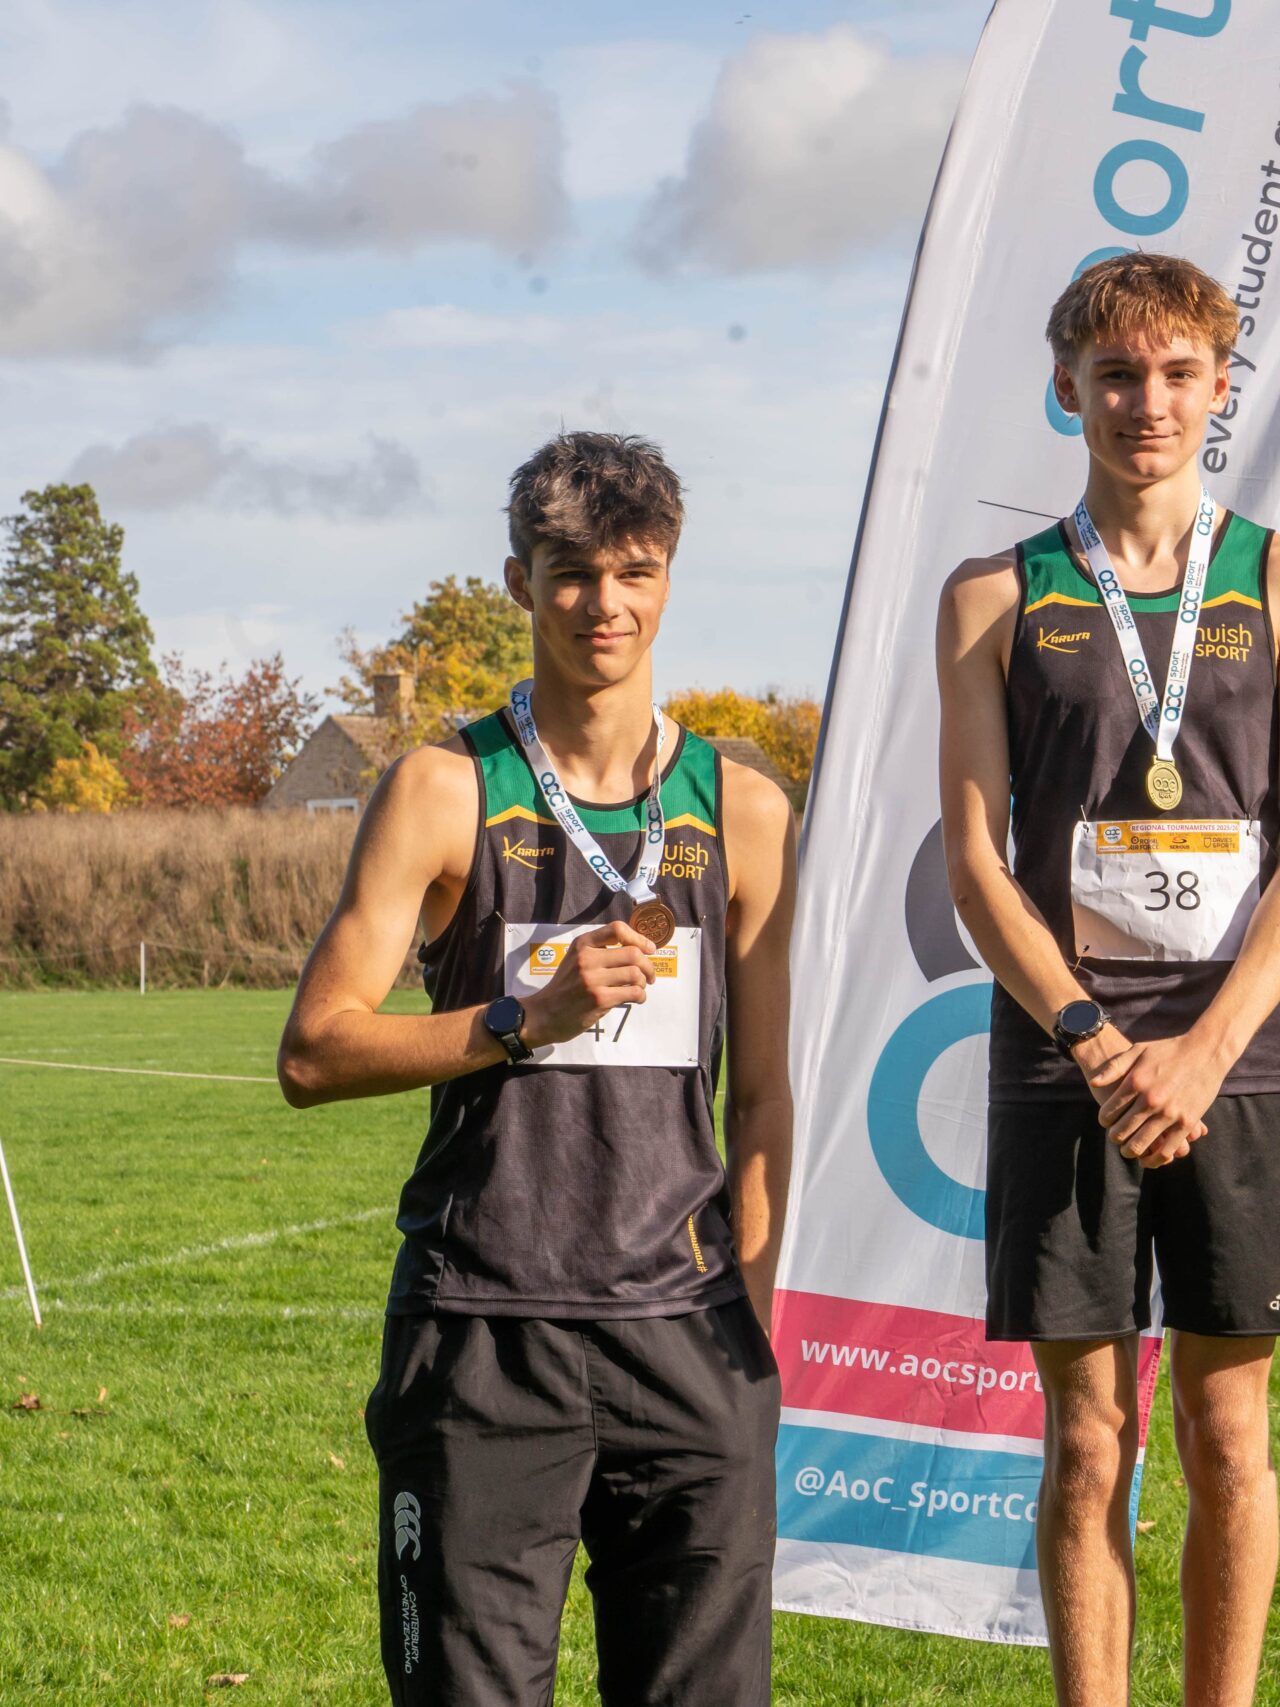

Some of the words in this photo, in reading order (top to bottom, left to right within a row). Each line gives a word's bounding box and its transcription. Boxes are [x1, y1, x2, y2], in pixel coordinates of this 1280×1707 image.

[1186, 560, 1197, 585] sport
[1119, 604, 1134, 630] sport
[1170, 651, 1180, 678] sport
[1195, 643, 1250, 662] SPORT
[565, 808, 585, 832] sport
[664, 841, 709, 865] uish
[657, 862, 705, 881] PORT
[1144, 871, 1201, 911] 38
[409, 1591, 419, 1663] CANTERBURY
[403, 1621, 412, 1674] ZEALAND
